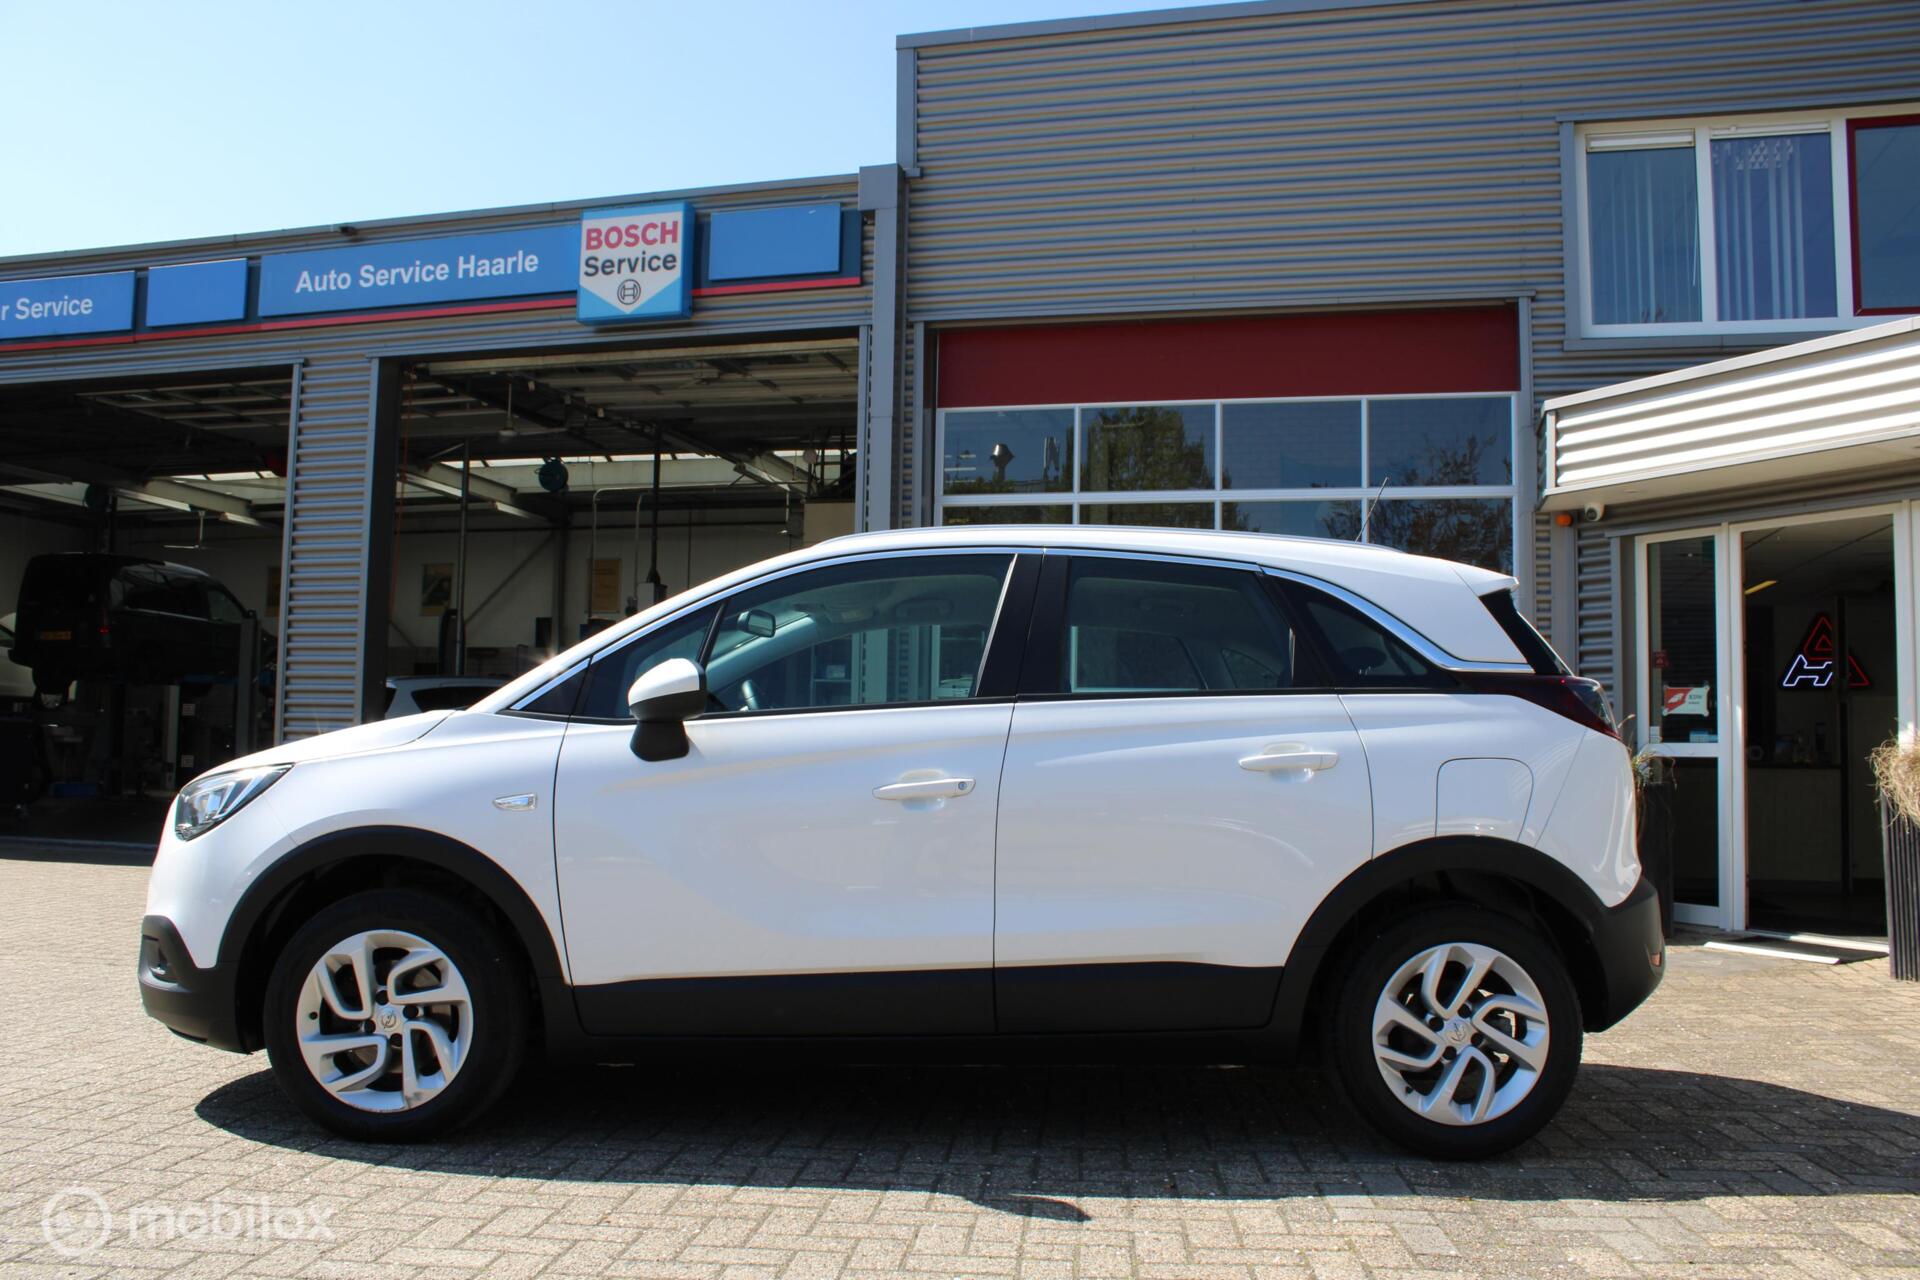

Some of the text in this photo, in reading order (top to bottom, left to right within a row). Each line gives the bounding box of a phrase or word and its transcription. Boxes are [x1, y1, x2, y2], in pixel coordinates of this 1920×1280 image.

[586, 220, 678, 250] BOSCH
[295, 250, 539, 293] Auto Service Haarle
[584, 250, 677, 277] Service
[15, 295, 93, 320] Service
